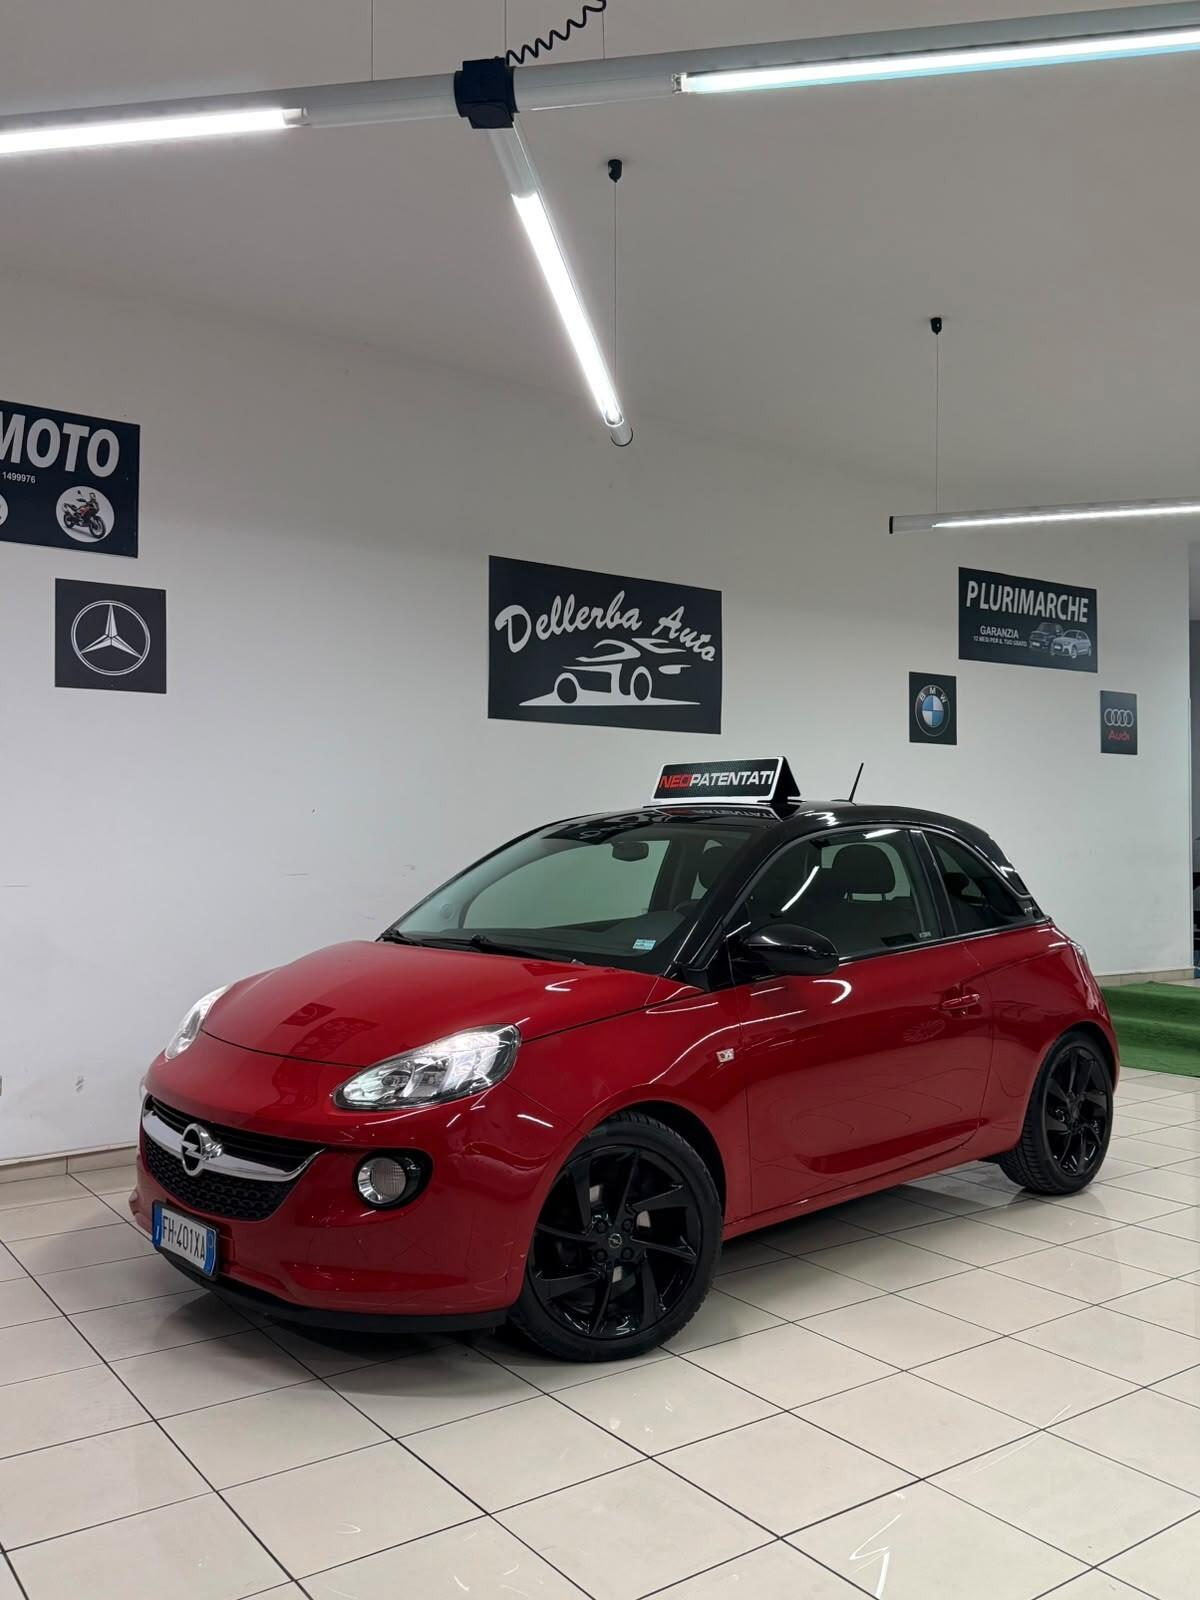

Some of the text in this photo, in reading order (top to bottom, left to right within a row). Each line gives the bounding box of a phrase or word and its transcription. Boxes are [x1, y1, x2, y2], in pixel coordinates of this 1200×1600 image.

[966, 580, 1089, 623] PLURIMARCHE
[494, 590, 716, 662] Dellerba Auto
[979, 625, 1019, 639] GARANZIA
[919, 687, 949, 703] BMW
[1107, 730, 1131, 741] Audi
